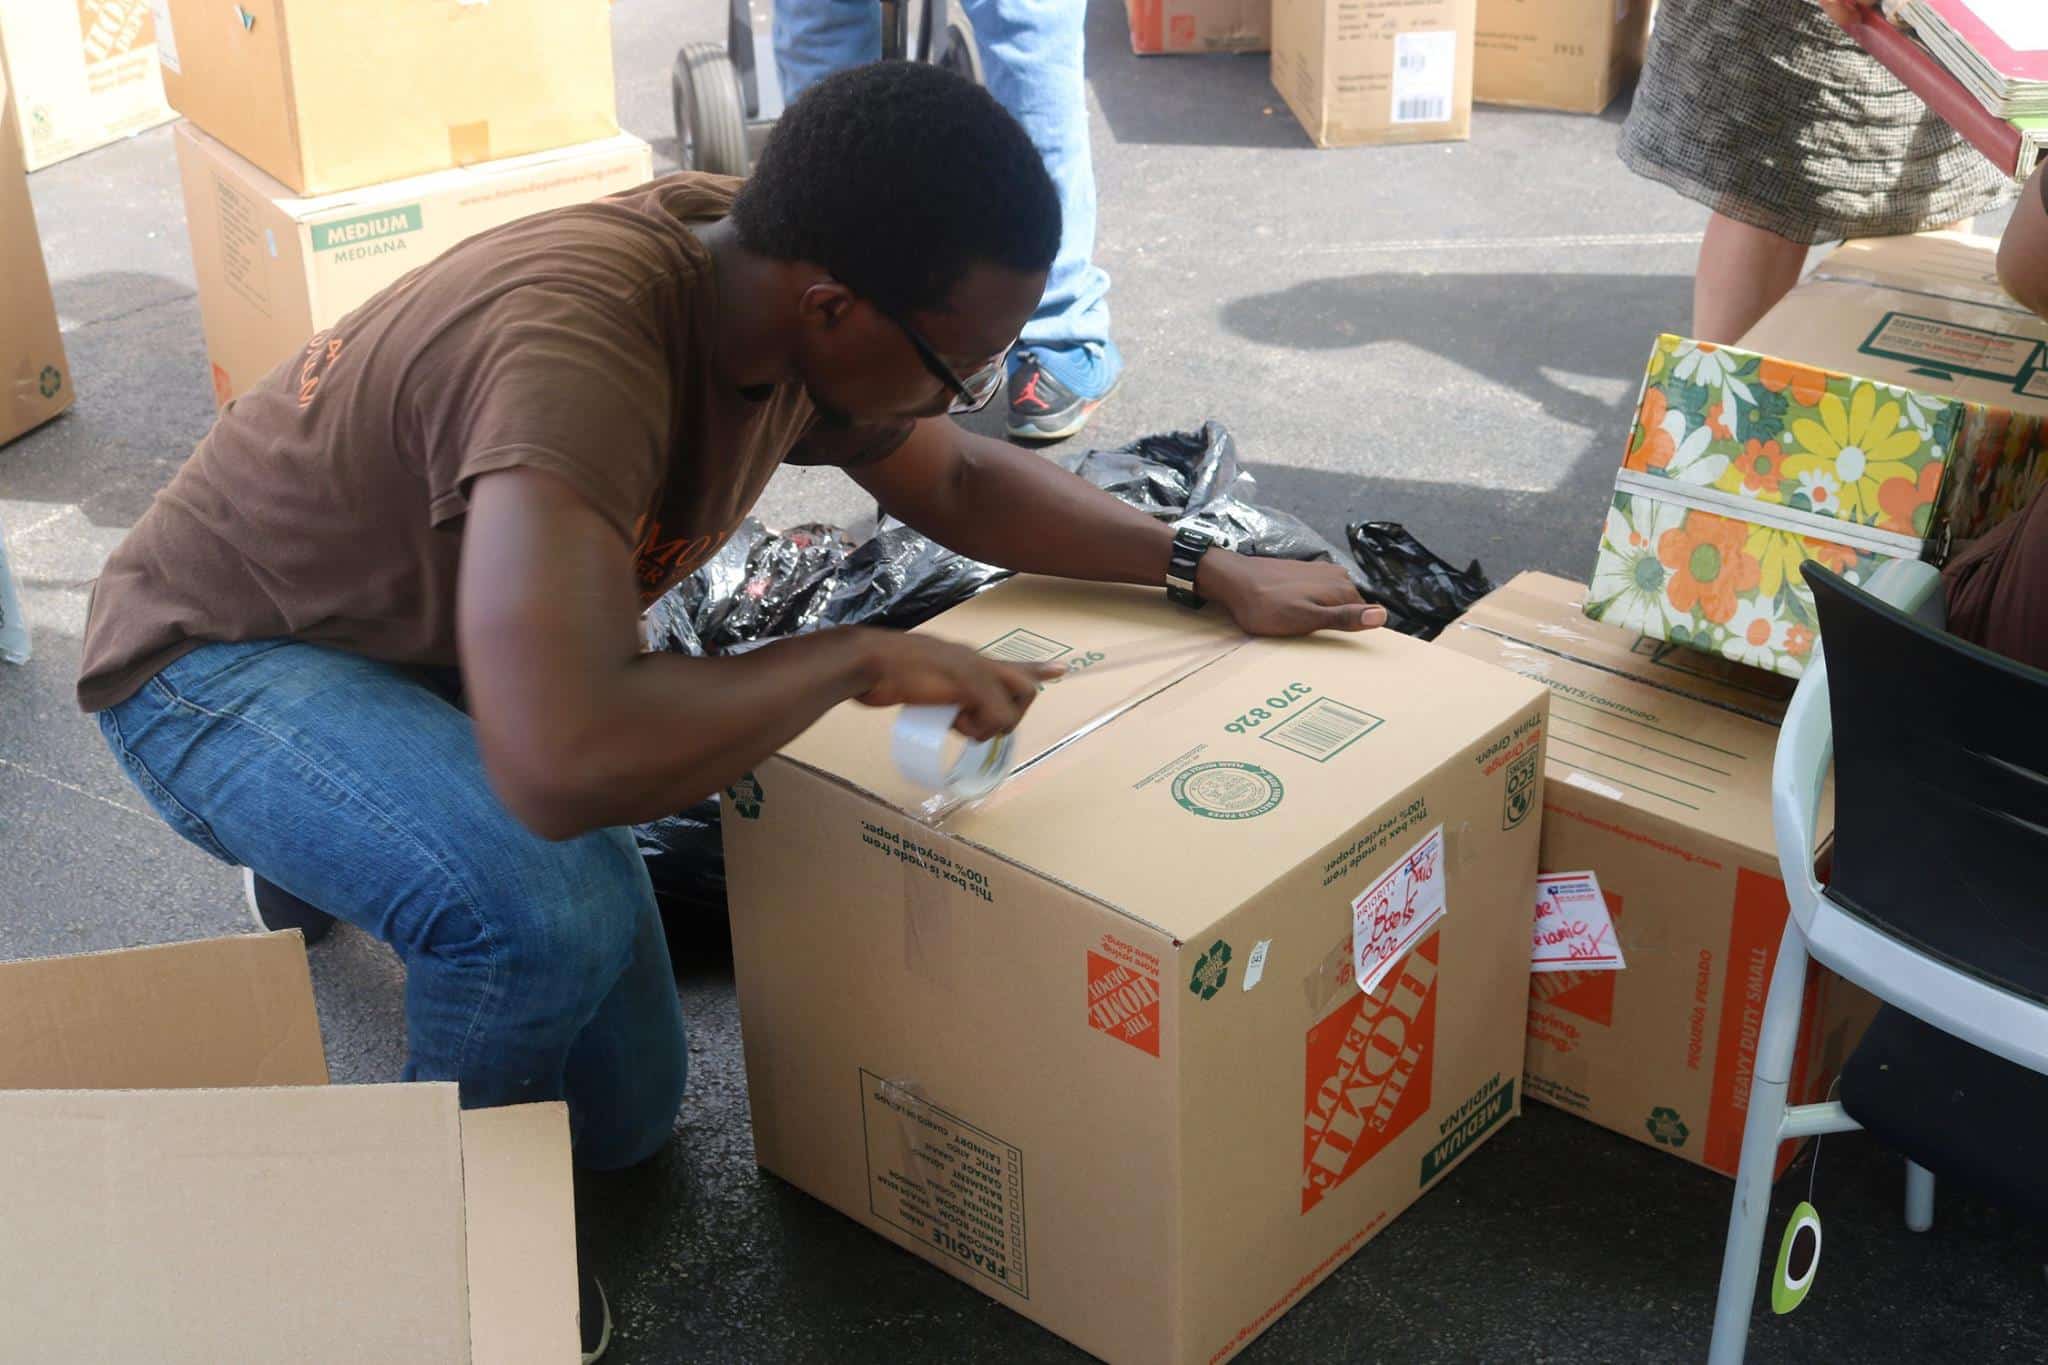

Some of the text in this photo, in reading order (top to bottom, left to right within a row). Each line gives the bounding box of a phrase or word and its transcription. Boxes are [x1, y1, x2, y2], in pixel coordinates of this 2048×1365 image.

[327, 213, 409, 247] MEDIUM
[334, 239, 407, 265] MEDIANA
[1224, 682, 1312, 734] 370 826
[1475, 712, 1542, 765] Think Green.
[1508, 764, 1535, 794] ECO
[1323, 796, 1425, 872] 100% recycled paper.
[1323, 807, 1428, 887] This box is made from
[861, 820, 989, 887] 100% recycled paper.
[862, 833, 993, 903] This box is made from
[1088, 966, 1131, 999] DEPOT
[1696, 948, 1713, 1005] PESADO
[1088, 977, 1160, 1029] HOME
[1122, 1013, 1152, 1039] THE
[1730, 946, 1769, 1110] HEAVY DUTY SMALL
[1301, 953, 1438, 1191] HOME
[1440, 1072, 1501, 1137] MEDIANA
[1434, 1094, 1502, 1167] MEDIUM
[954, 1133, 1000, 1164] LAUNDRY
[960, 1160, 1001, 1189] GARAGE
[975, 1156, 1000, 1177] ATTIC
[951, 1167, 1002, 1201] BASEMENT
[935, 1194, 965, 1217] ROOM
[938, 1207, 968, 1230] ROOM
[962, 1197, 1003, 1226] KITCHEN
[978, 1193, 1002, 1213] BATH
[968, 1211, 1003, 1238] DINING
[971, 1224, 1004, 1250] FAMILY
[932, 1226, 1005, 1280] FRAGILE
[957, 1229, 1005, 1262] BEDROOM
